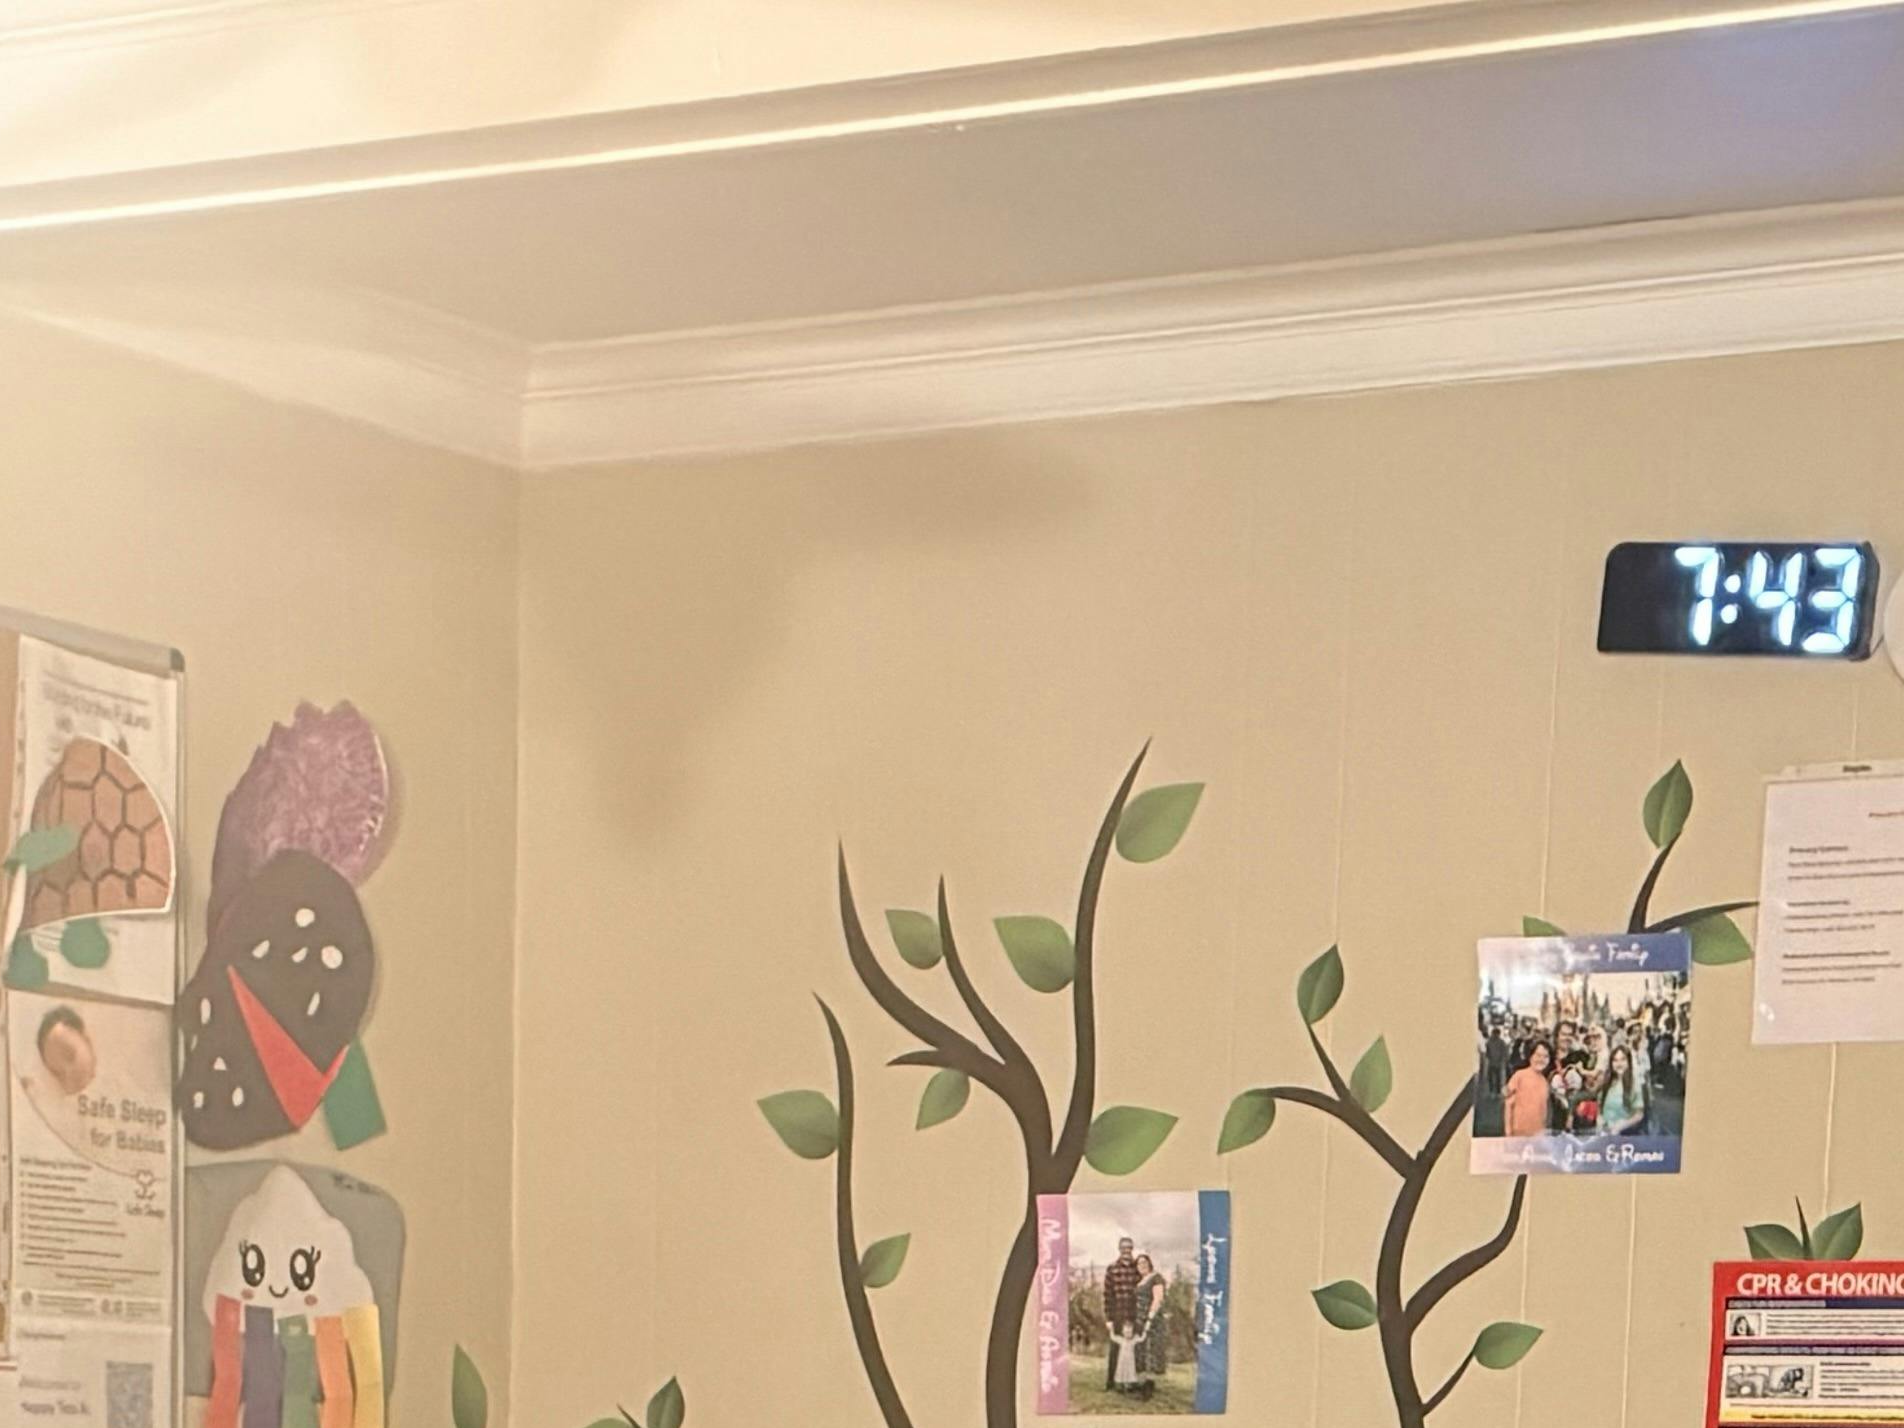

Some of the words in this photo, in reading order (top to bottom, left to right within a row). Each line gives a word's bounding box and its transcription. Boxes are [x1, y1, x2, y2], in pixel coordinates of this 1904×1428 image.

[1673, 547, 1863, 654] 7:43
[78, 1094, 115, 1119] Safe
[120, 1099, 166, 1129] Sleep
[1736, 1273, 1782, 1296] CPR
[1783, 1273, 1804, 1294] &
